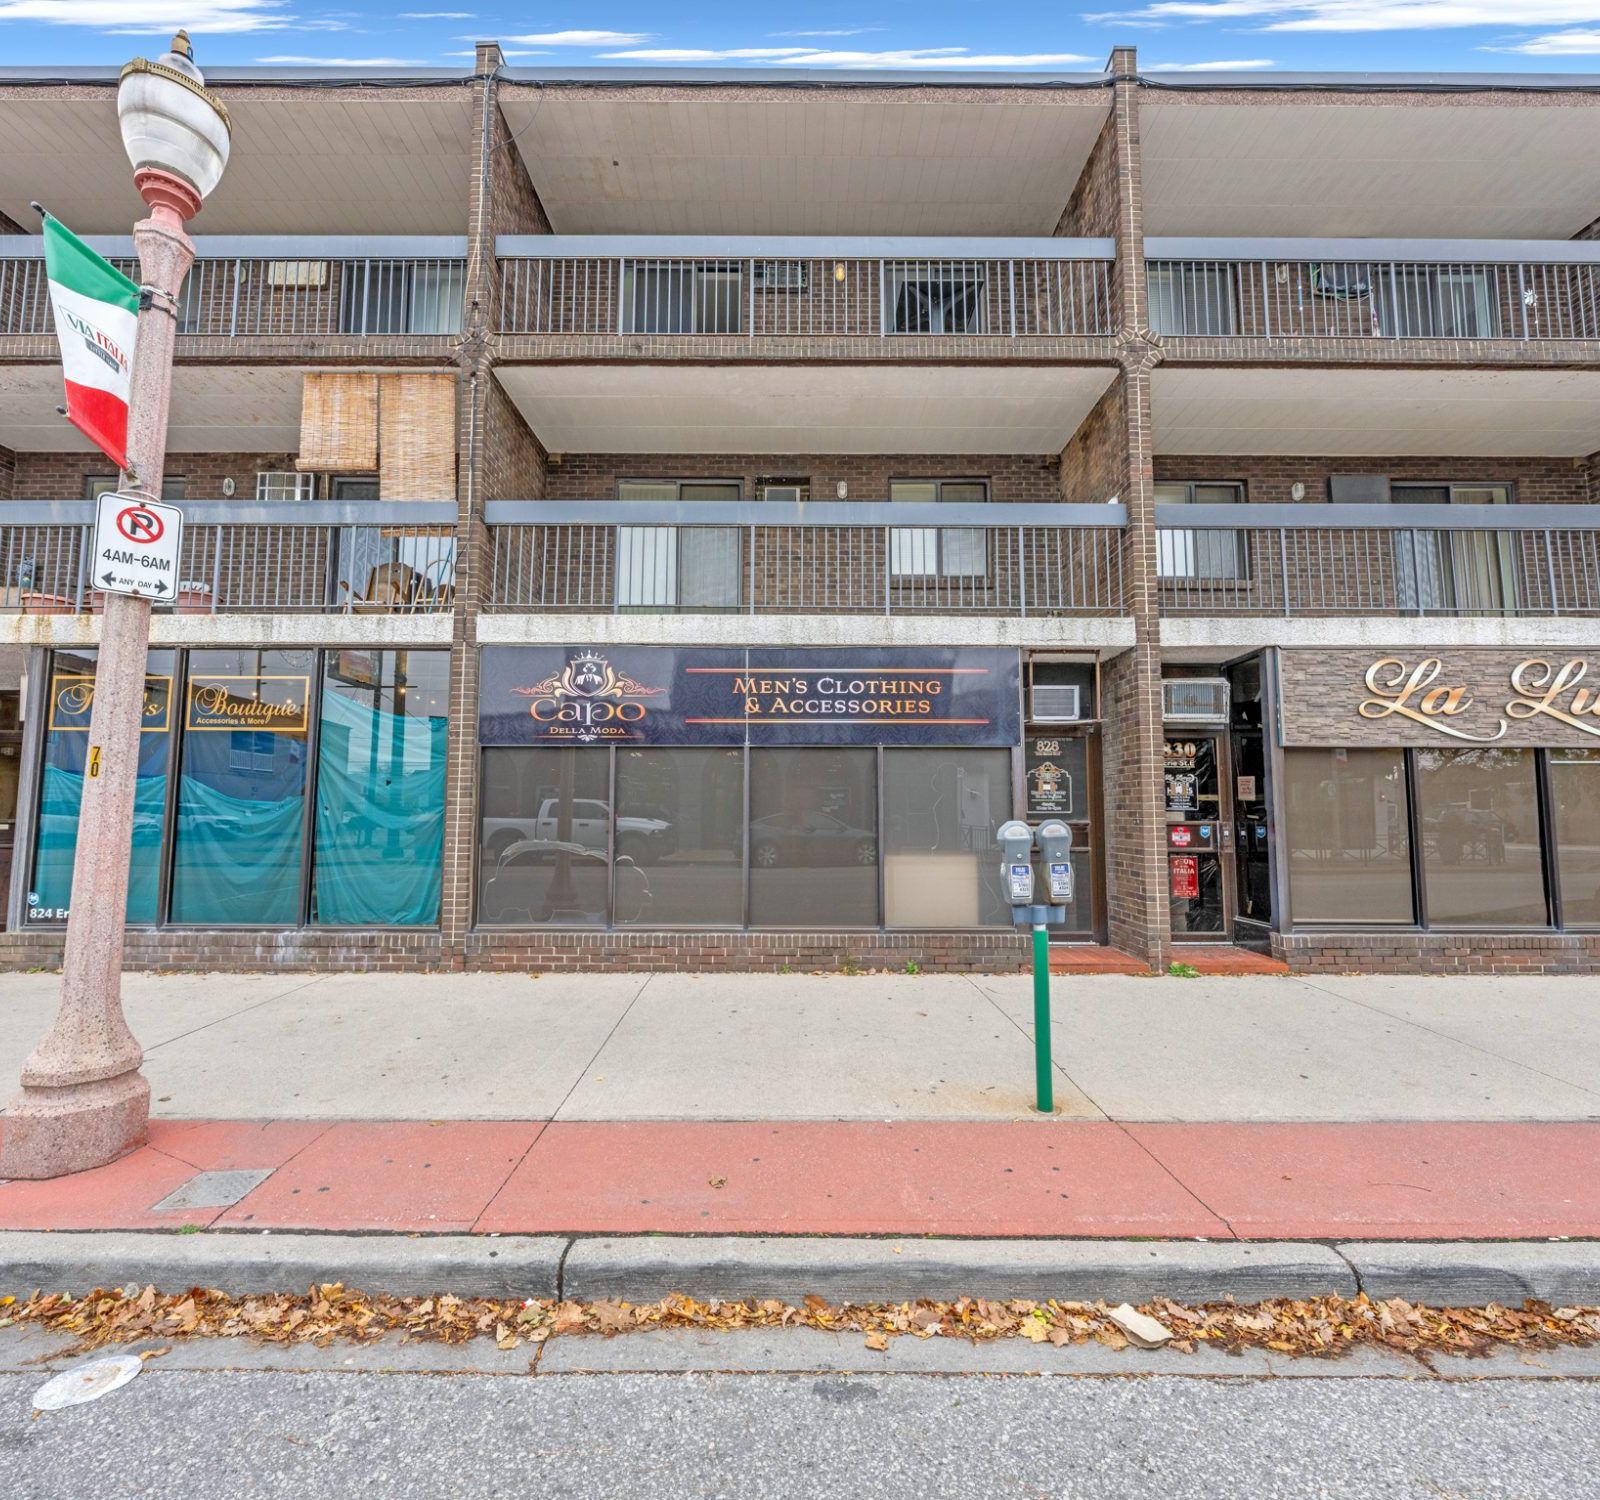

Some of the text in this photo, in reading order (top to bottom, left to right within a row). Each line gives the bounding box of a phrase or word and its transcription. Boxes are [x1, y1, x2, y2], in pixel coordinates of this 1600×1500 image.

[67, 313, 95, 340] VIA
[96, 331, 128, 373] ITALIA
[102, 548, 171, 571] 4AM-6AM
[118, 577, 153, 588] ANY DAY
[816, 676, 942, 694] CLOTHING
[195, 682, 301, 724] Boutique
[744, 697, 931, 715] & ACCESSORIES
[1358, 658, 1507, 742] La
[195, 717, 239, 725] Accessories
[247, 717, 265, 725] More
[530, 698, 646, 726] Capo
[550, 726, 626, 734] DELLA MODA
[1036, 740, 1060, 752] 828
[29, 908, 53, 919] 824
